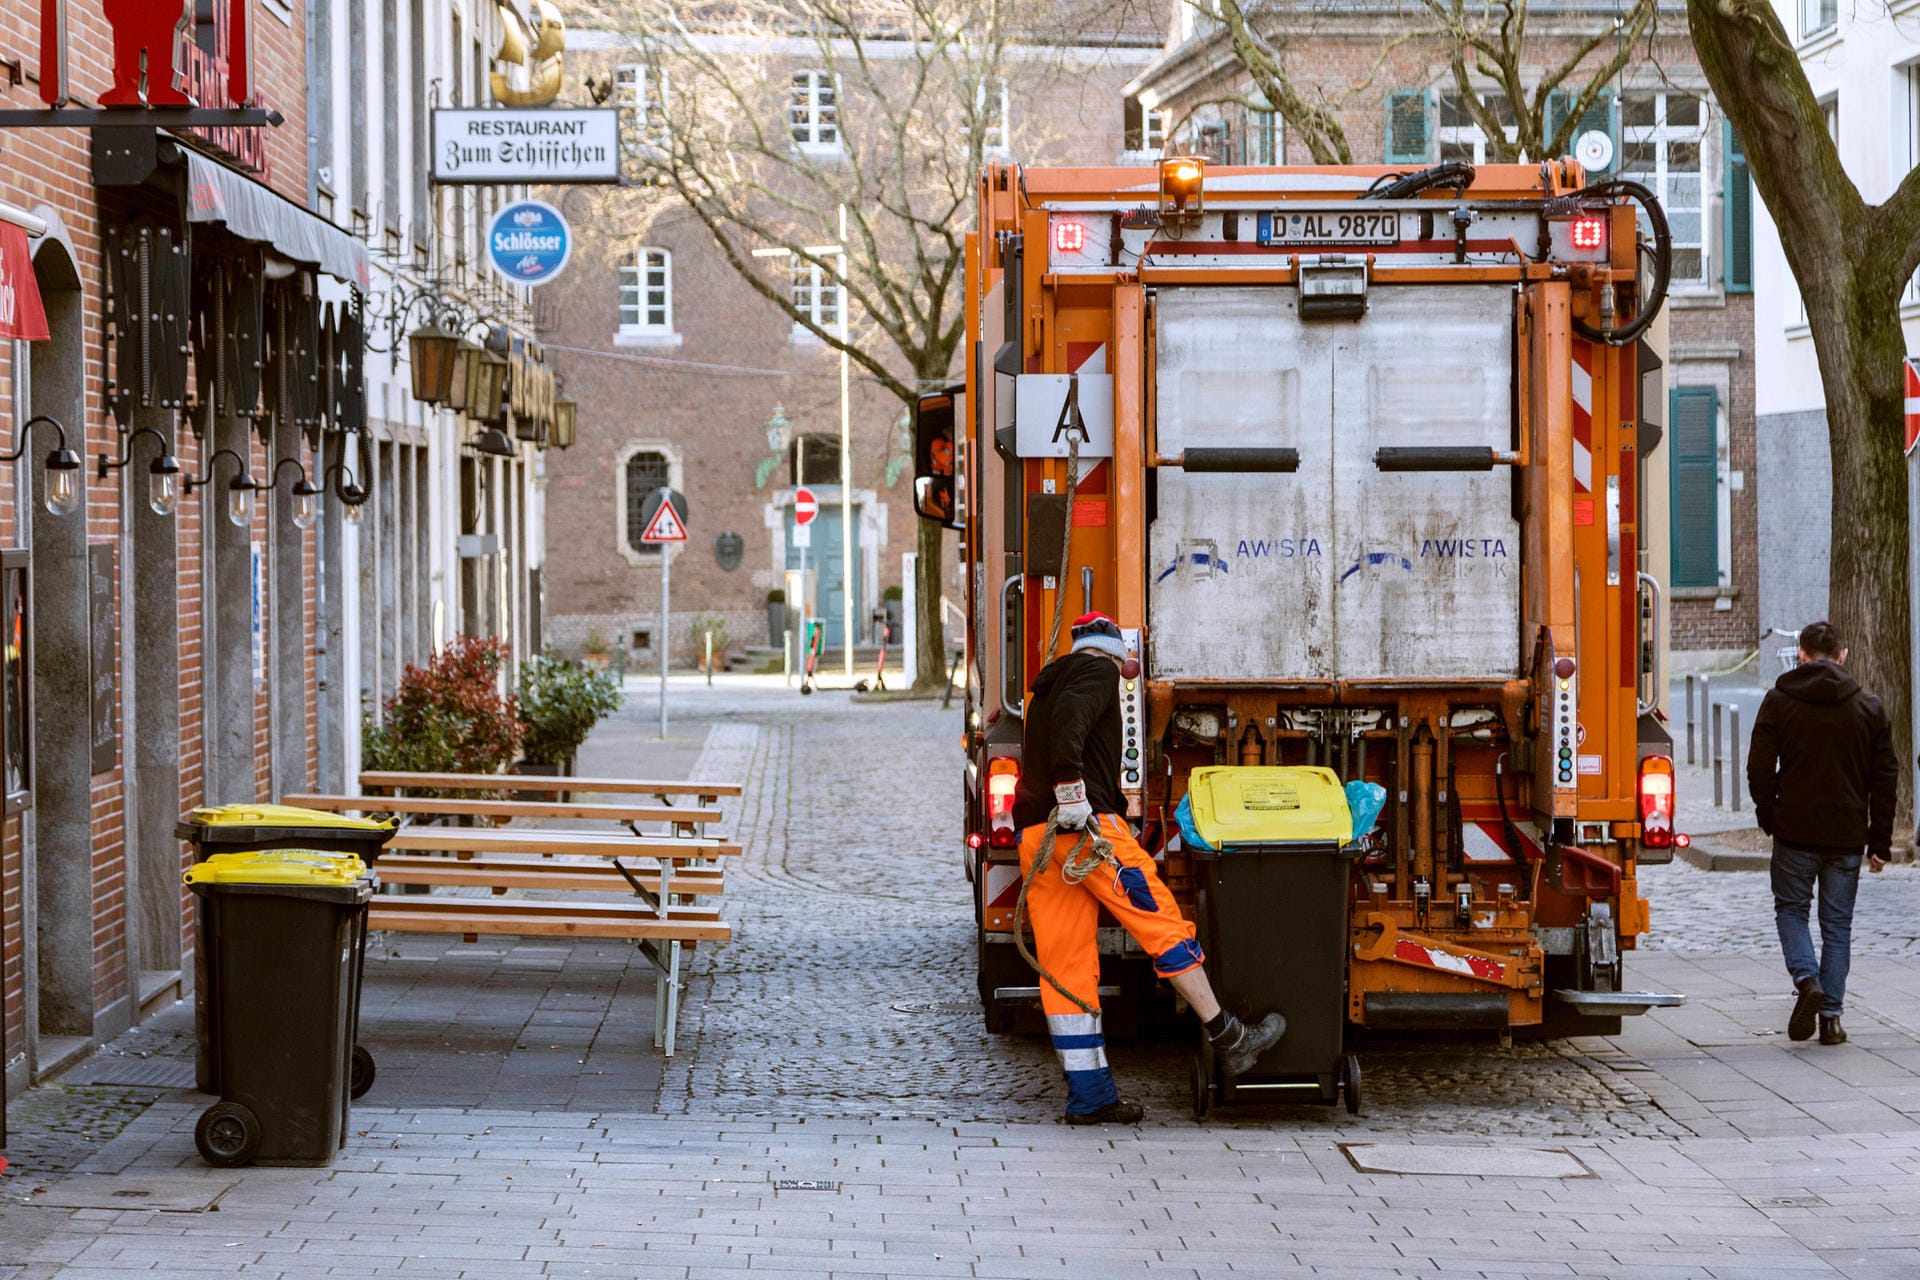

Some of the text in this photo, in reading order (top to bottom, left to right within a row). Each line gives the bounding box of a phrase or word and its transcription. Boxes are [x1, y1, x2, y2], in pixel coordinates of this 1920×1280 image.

[468, 120, 587, 136] RESTAURANT
[446, 140, 605, 170] Zum Schiffchen
[1273, 216, 1395, 238] D AL 9870
[494, 231, 561, 252] Schlösser
[1052, 386, 1091, 443] A
[1420, 538, 1507, 558] AWISTA
